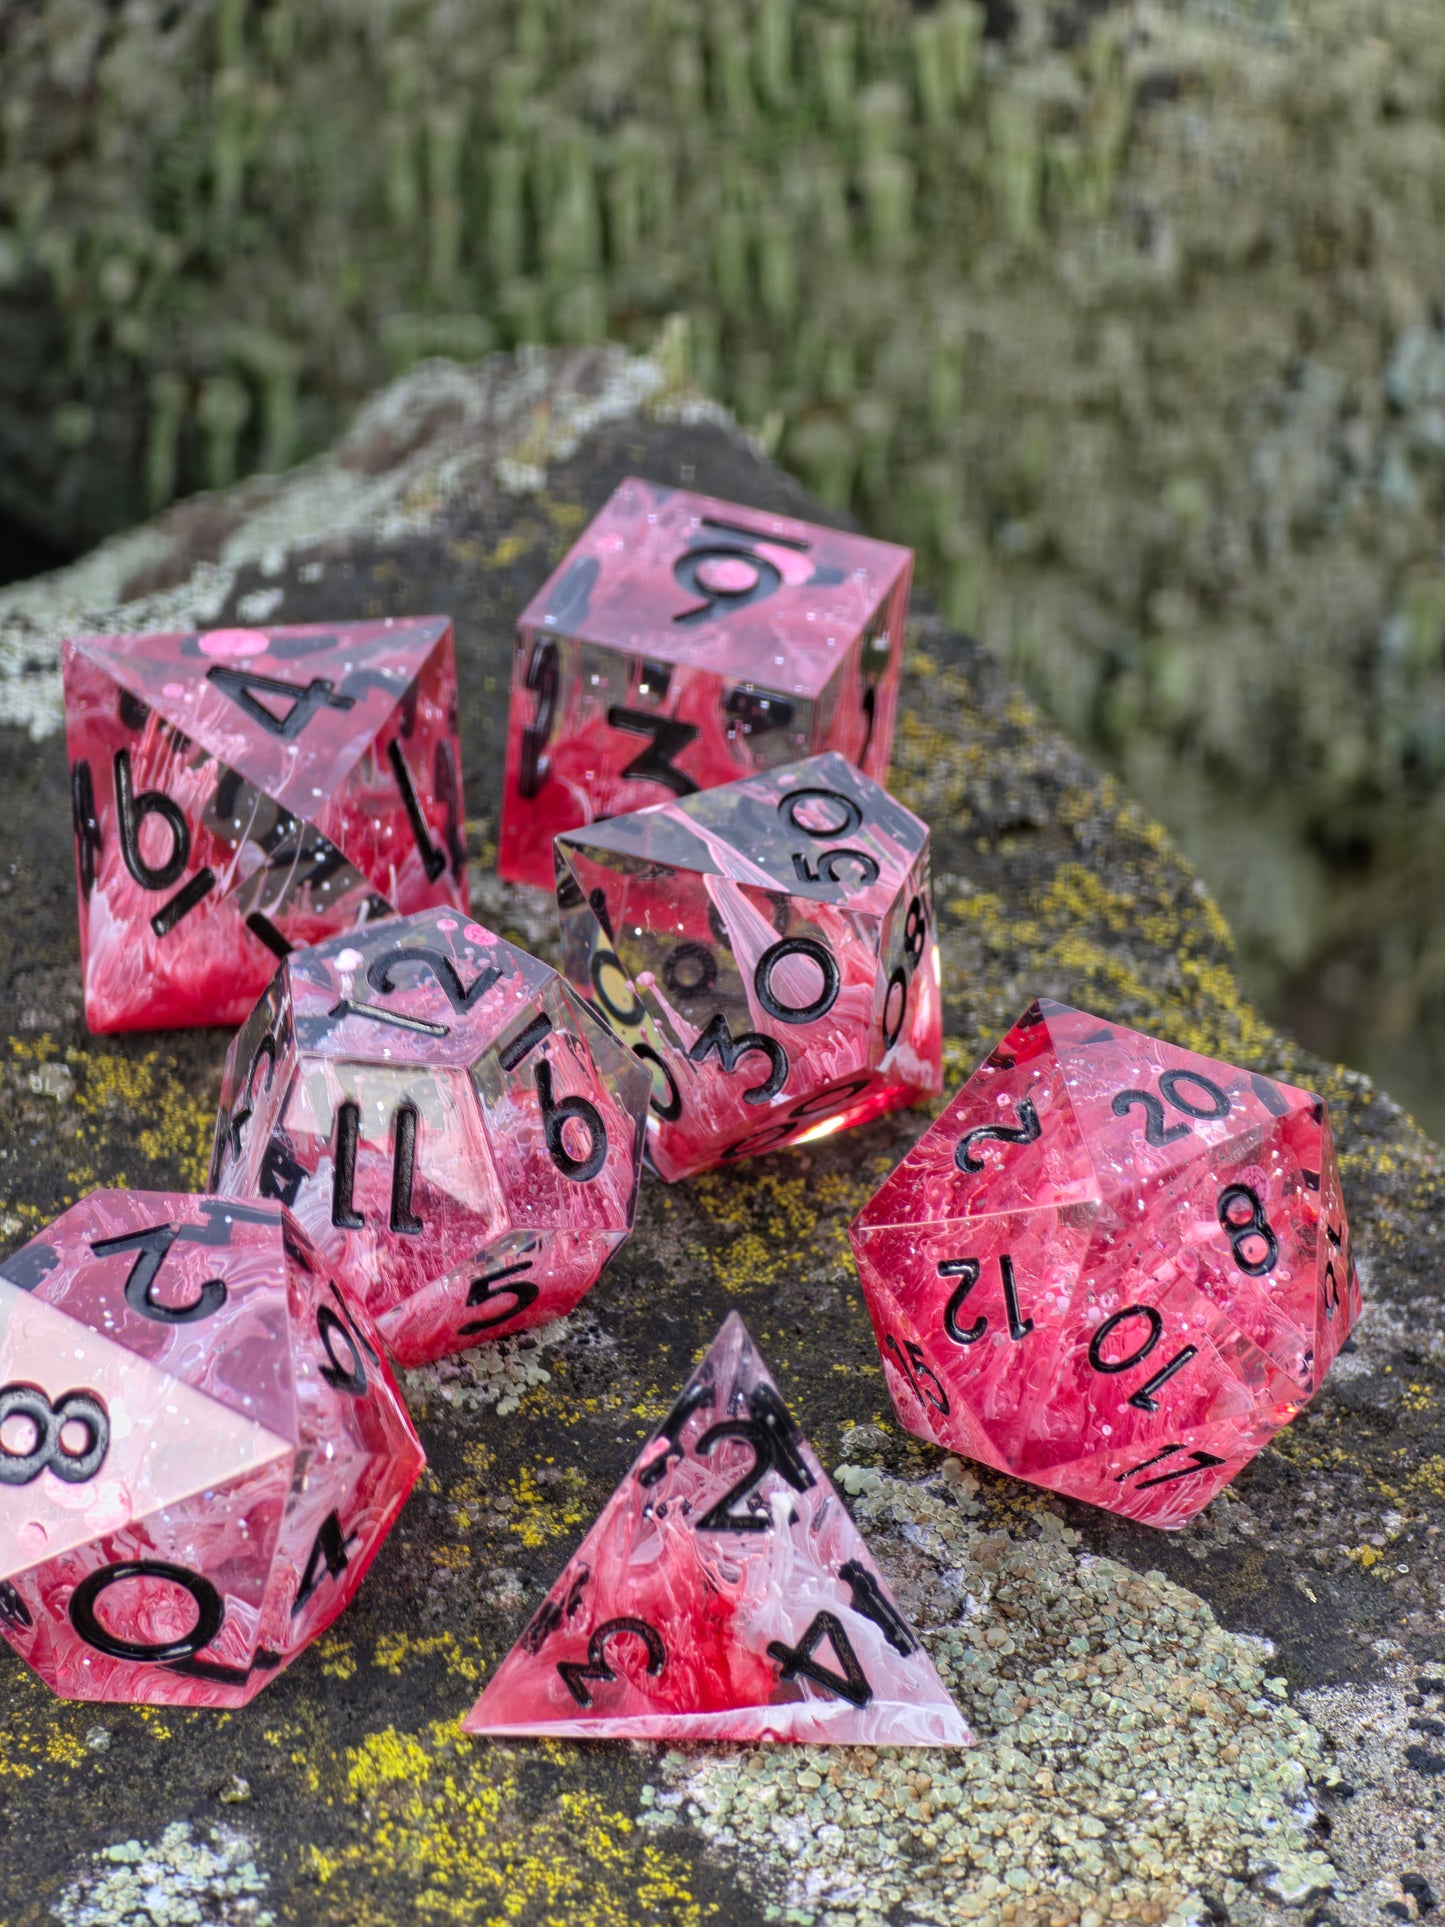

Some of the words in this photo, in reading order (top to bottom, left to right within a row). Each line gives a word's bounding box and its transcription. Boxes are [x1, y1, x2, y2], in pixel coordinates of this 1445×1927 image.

[206, 665, 356, 739] 4
[777, 788, 880, 887] 50
[327, 946, 504, 1038] 12
[689, 936, 841, 1106] 30
[954, 1097, 1043, 1175] 2
[1111, 1067, 1233, 1148] 20
[331, 1098, 424, 1236] 11
[89, 1220, 229, 1325] 2
[1216, 1182, 1281, 1278] 8
[457, 1260, 541, 1337] 5
[936, 1253, 1035, 1346] 12
[885, 1334, 951, 1417] 15
[1087, 1303, 1199, 1413] 10
[0, 1380, 112, 1486] 8
[694, 1418, 776, 1534] 2
[68, 1558, 227, 1663] 0
[555, 1615, 667, 1710] 3
[765, 1608, 876, 1711] 4
